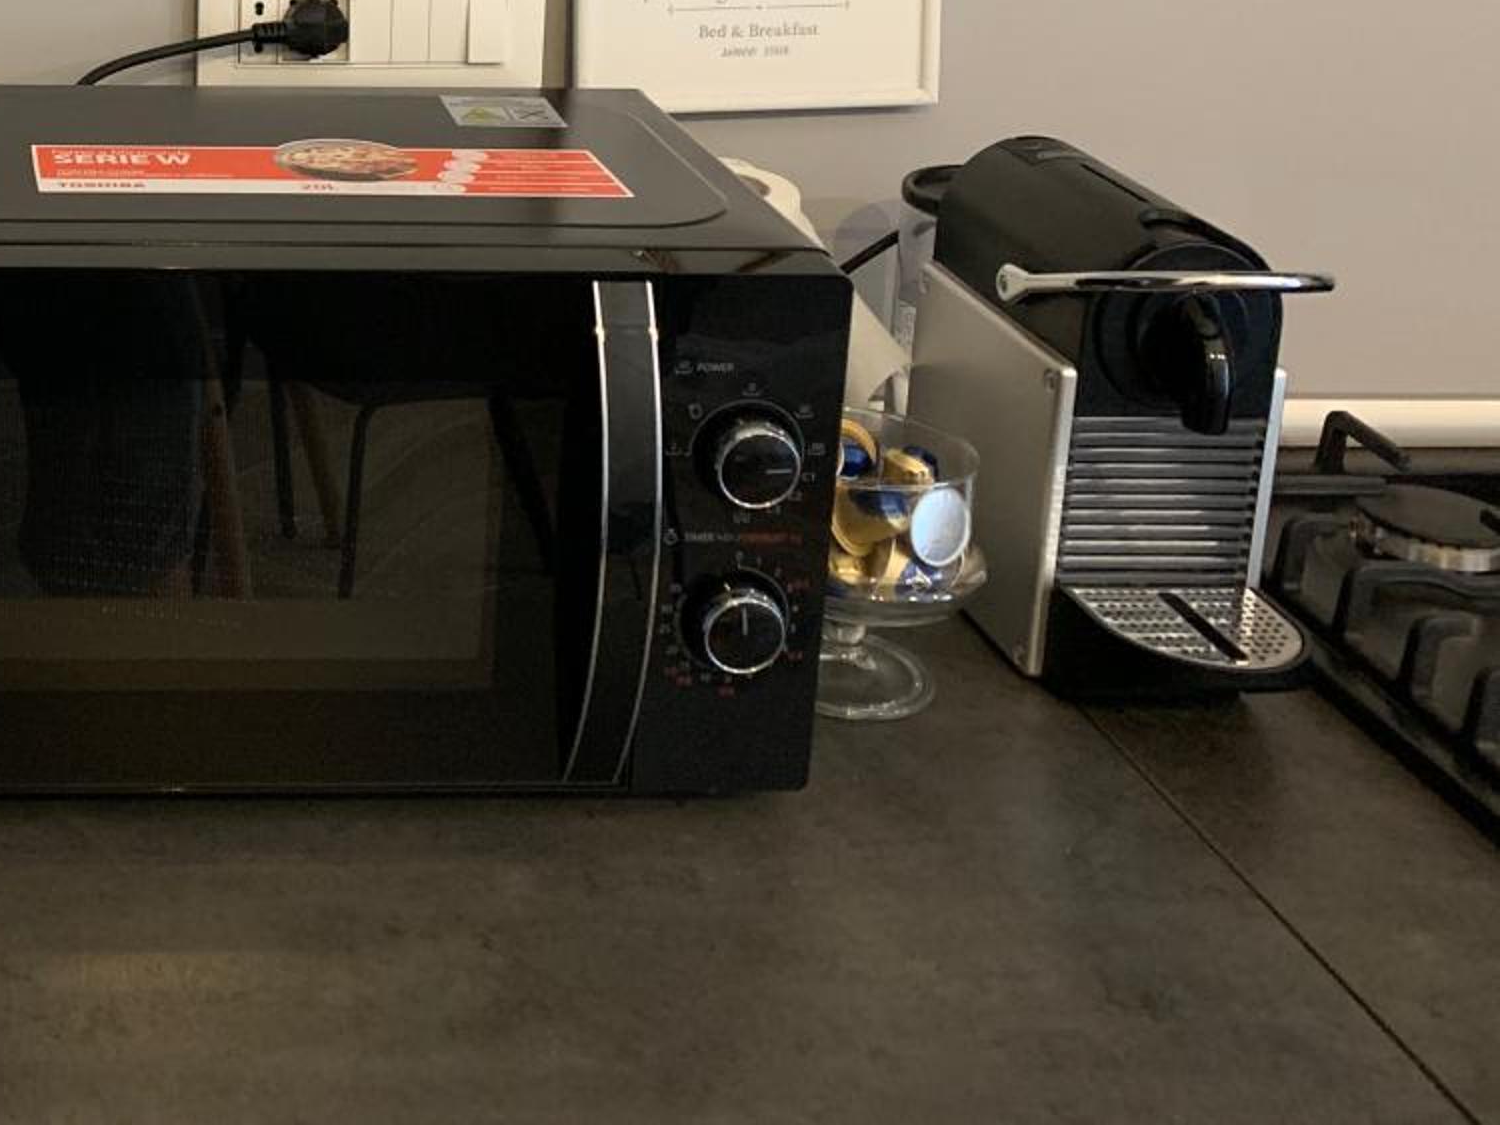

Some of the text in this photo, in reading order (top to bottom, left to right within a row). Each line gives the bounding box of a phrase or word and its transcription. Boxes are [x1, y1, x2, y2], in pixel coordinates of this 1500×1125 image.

[699, 22, 819, 39] Bed & Breakfast
[54, 154, 191, 166] SERIE W
[696, 362, 735, 374] POWER
